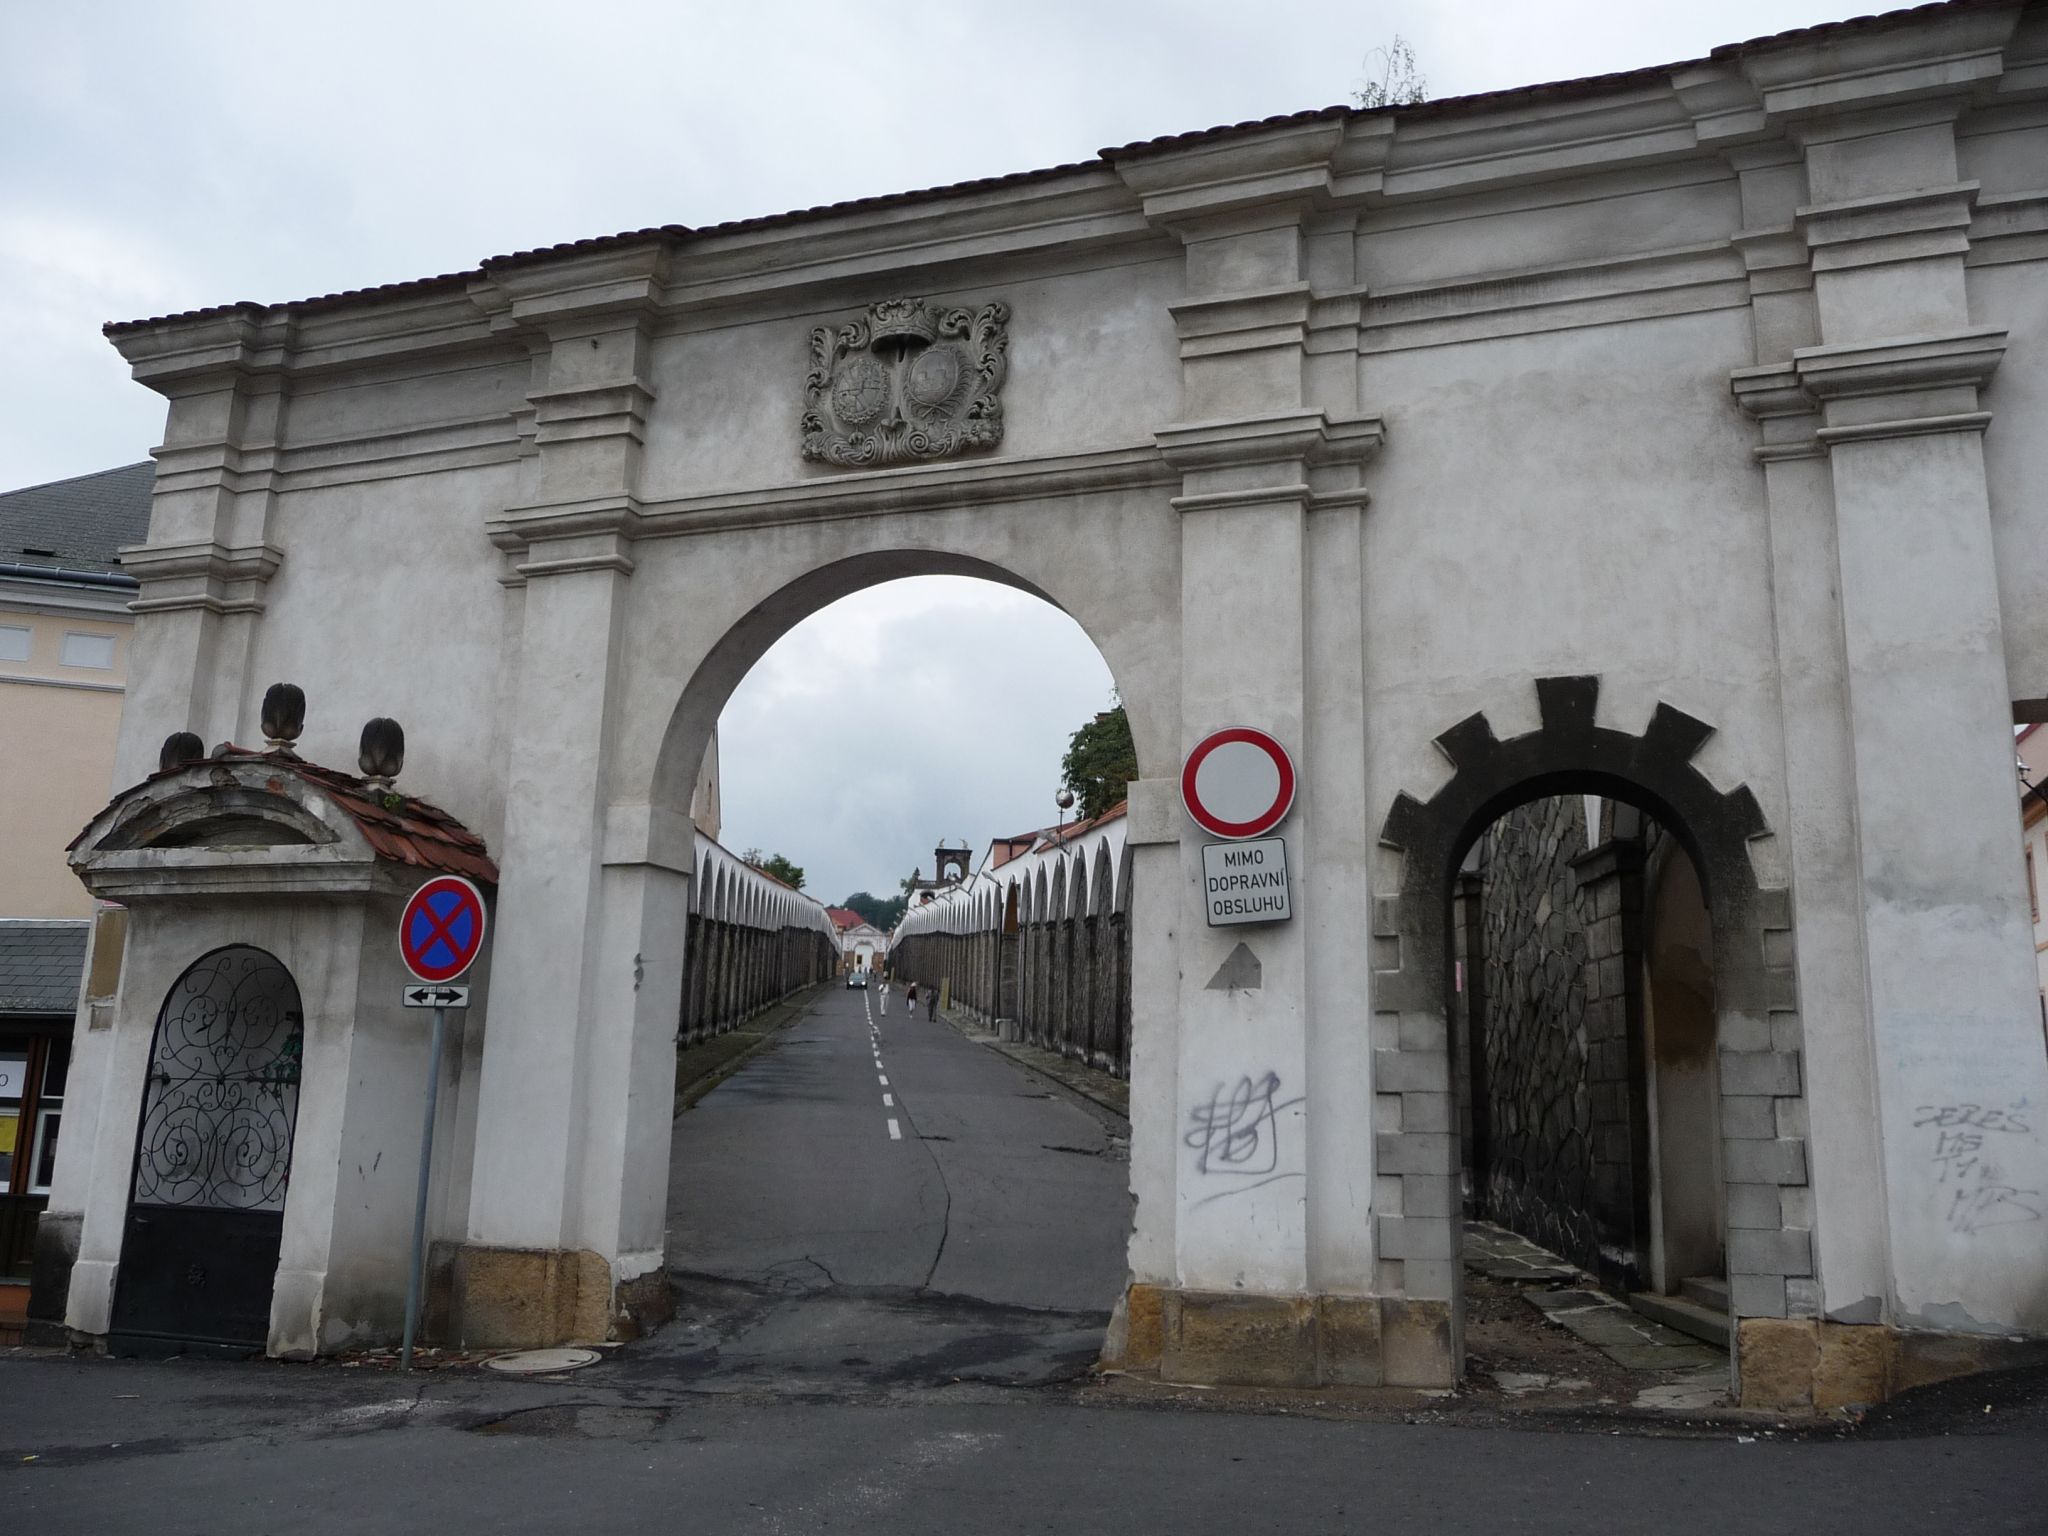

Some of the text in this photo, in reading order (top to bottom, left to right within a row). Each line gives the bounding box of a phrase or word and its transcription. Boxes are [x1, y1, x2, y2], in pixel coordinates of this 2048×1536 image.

[1224, 849, 1264, 868] MIMO
[1208, 867, 1285, 893] DOPRAVNÍ
[1213, 895, 1284, 916] OBSLUHU
